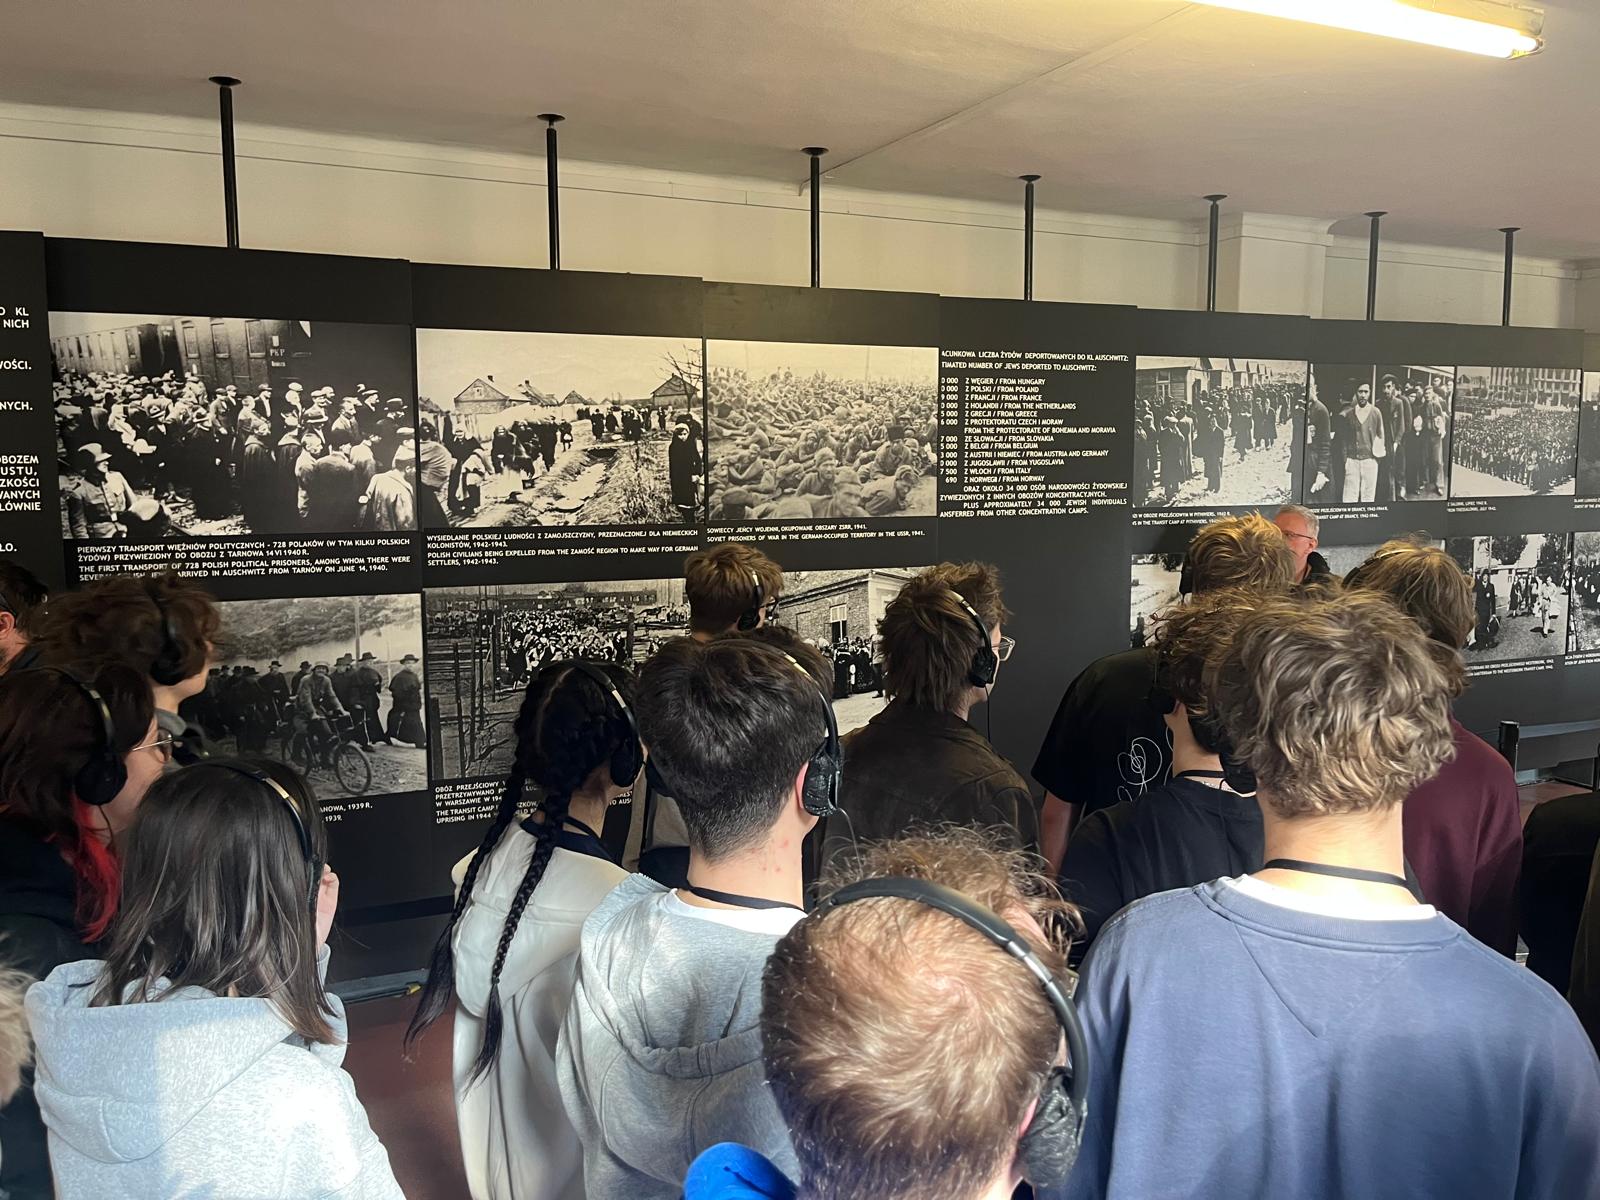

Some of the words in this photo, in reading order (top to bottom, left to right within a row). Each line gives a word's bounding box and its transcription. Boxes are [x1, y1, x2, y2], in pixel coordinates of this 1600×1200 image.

[15, 306, 30, 316] KL
[3, 318, 30, 328] NICH
[0, 455, 39, 464] BOZEM
[77, 546, 117, 554] PIERWSZY
[209, 542, 265, 550] POLITYCZNYCH
[288, 539, 324, 548] POLAKÓW
[78, 552, 111, 562] ŻYDÓW)
[227, 550, 264, 558] TARNOWA
[292, 565, 322, 573] TARNÓW
[456, 781, 499, 790] PRZEJŚCIOWY
[436, 789, 494, 800] PRZETRZYMYWANO
[445, 798, 481, 806] WARSZAWIE
